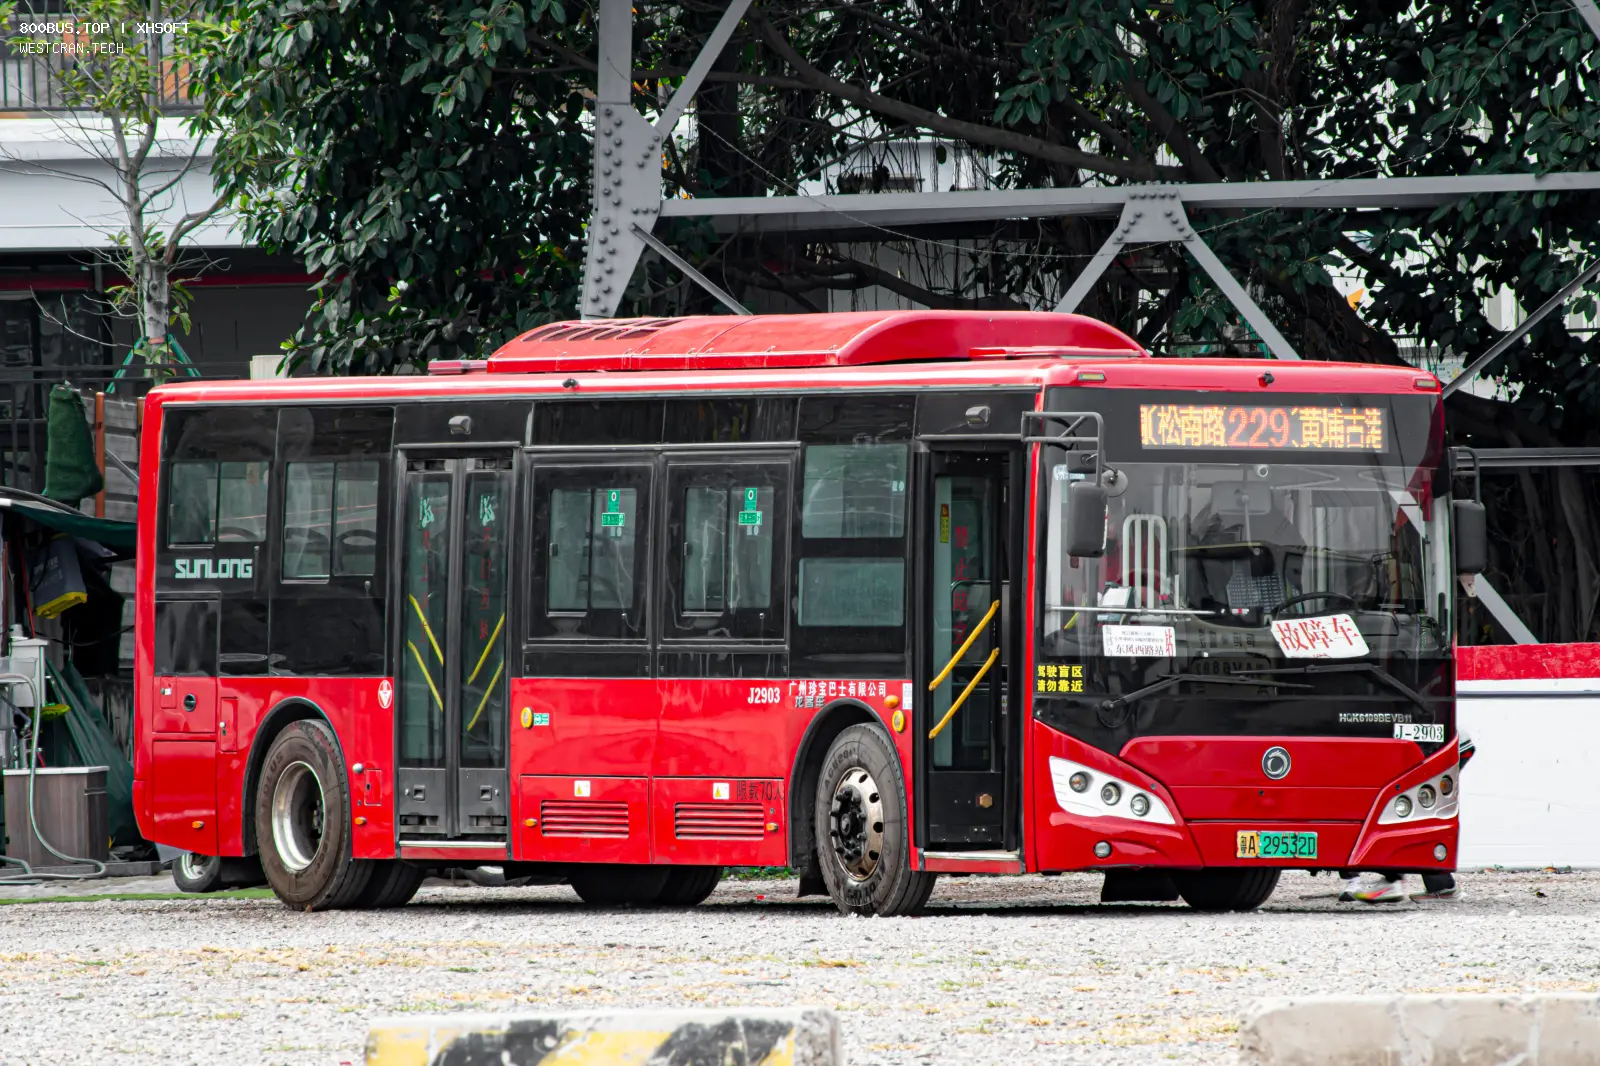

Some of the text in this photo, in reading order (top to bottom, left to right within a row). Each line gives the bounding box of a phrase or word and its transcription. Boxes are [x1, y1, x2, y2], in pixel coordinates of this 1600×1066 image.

[1228, 407, 1290, 448] 229
[174, 558, 253, 579] SUNLONG
[1276, 617, 1360, 652] 故障车
[1037, 664, 1083, 678] 驾驶盲区
[788, 680, 887, 698] 广州珍宝巴士有限公司
[1037, 679, 1083, 692] 请勿靠近
[747, 687, 781, 704] J2903
[1395, 725, 1444, 741] J-2903
